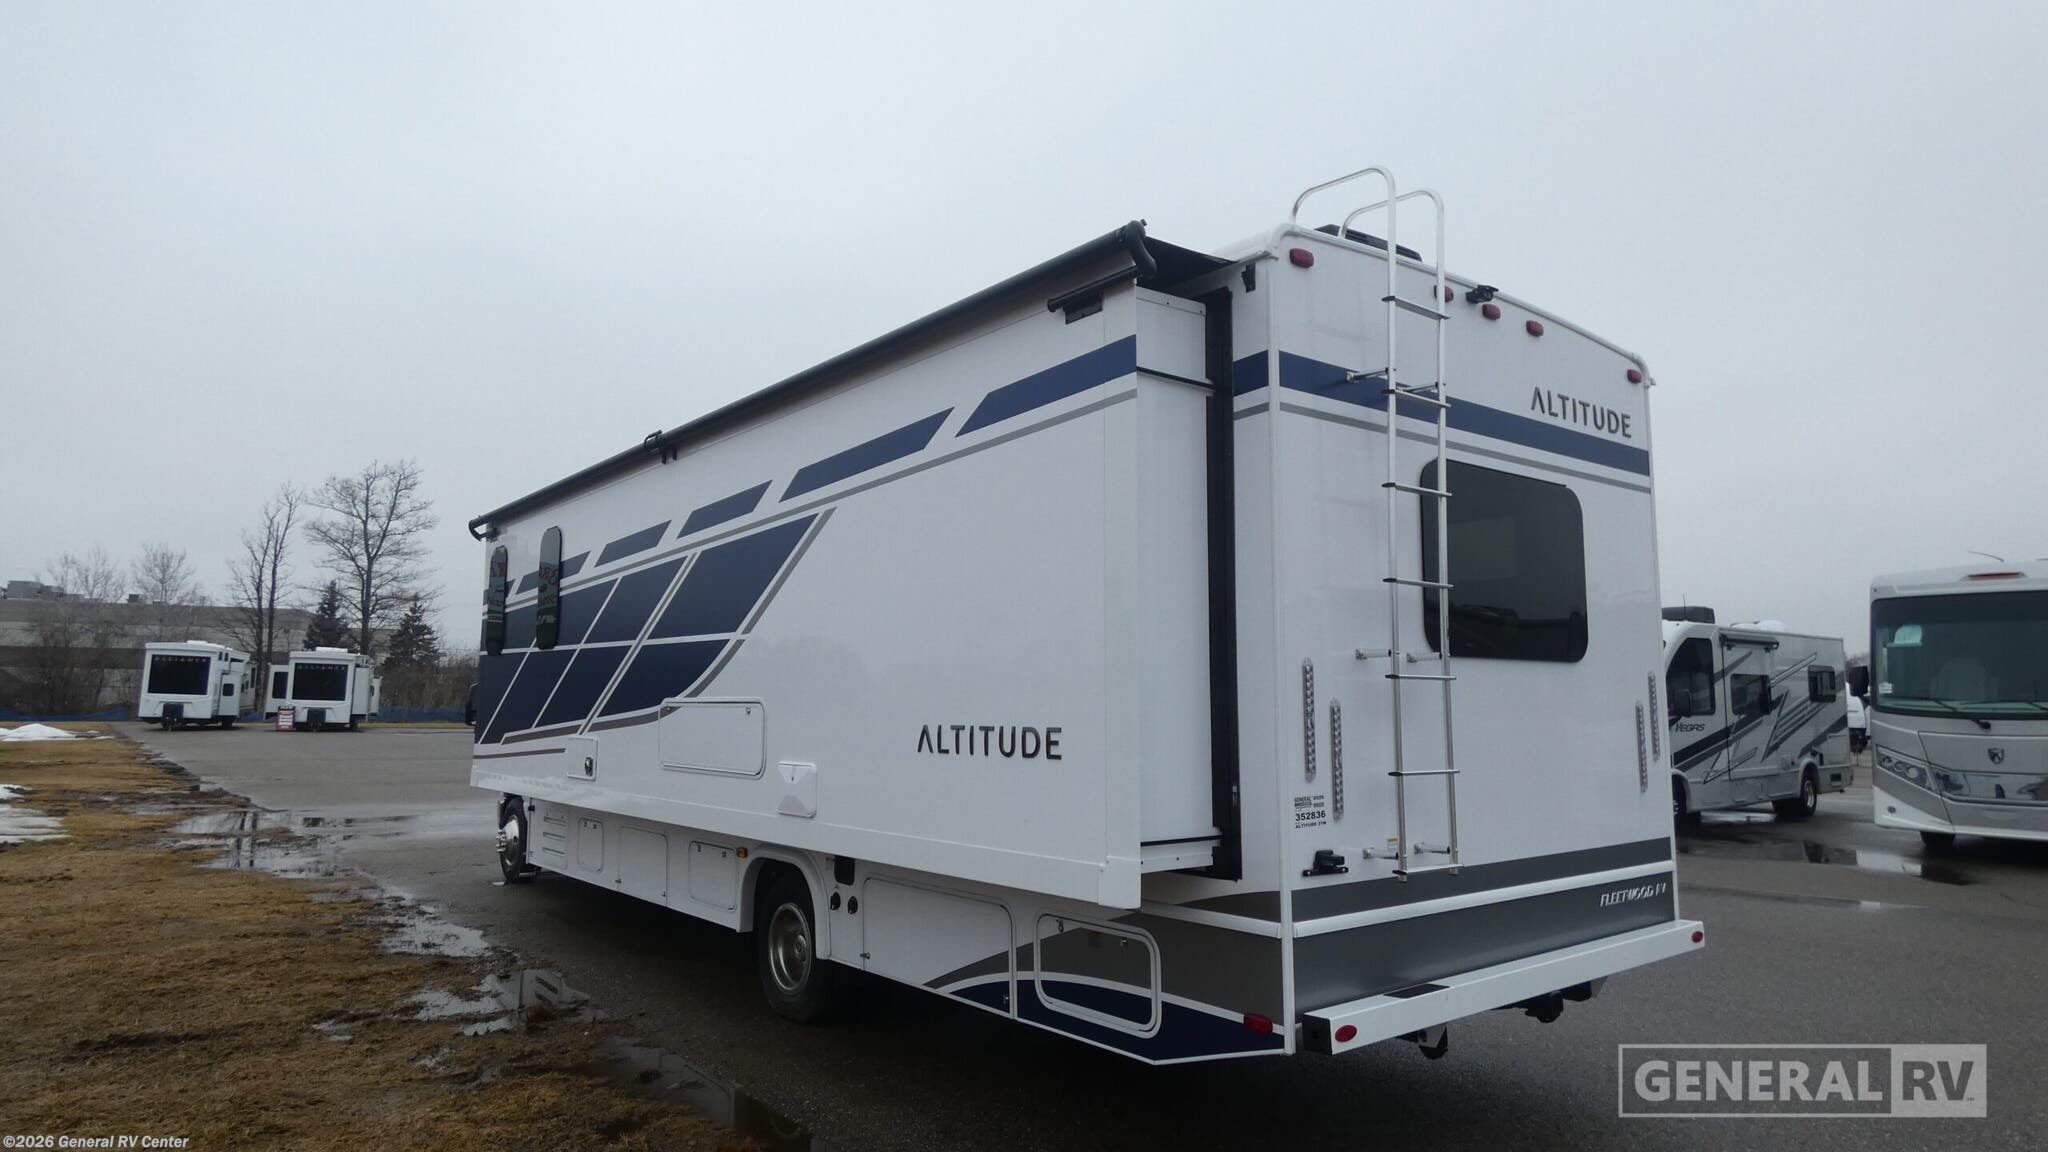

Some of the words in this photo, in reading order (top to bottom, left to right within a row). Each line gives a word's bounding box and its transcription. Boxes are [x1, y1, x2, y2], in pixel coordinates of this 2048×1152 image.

[1531, 386, 1632, 438] ALTITUDE
[1675, 722, 1706, 733] VEGAS
[917, 724, 1062, 760] ALTITUDE
[1295, 810, 1326, 822] 352836
[1600, 885, 1654, 907] FLEETWOOD
